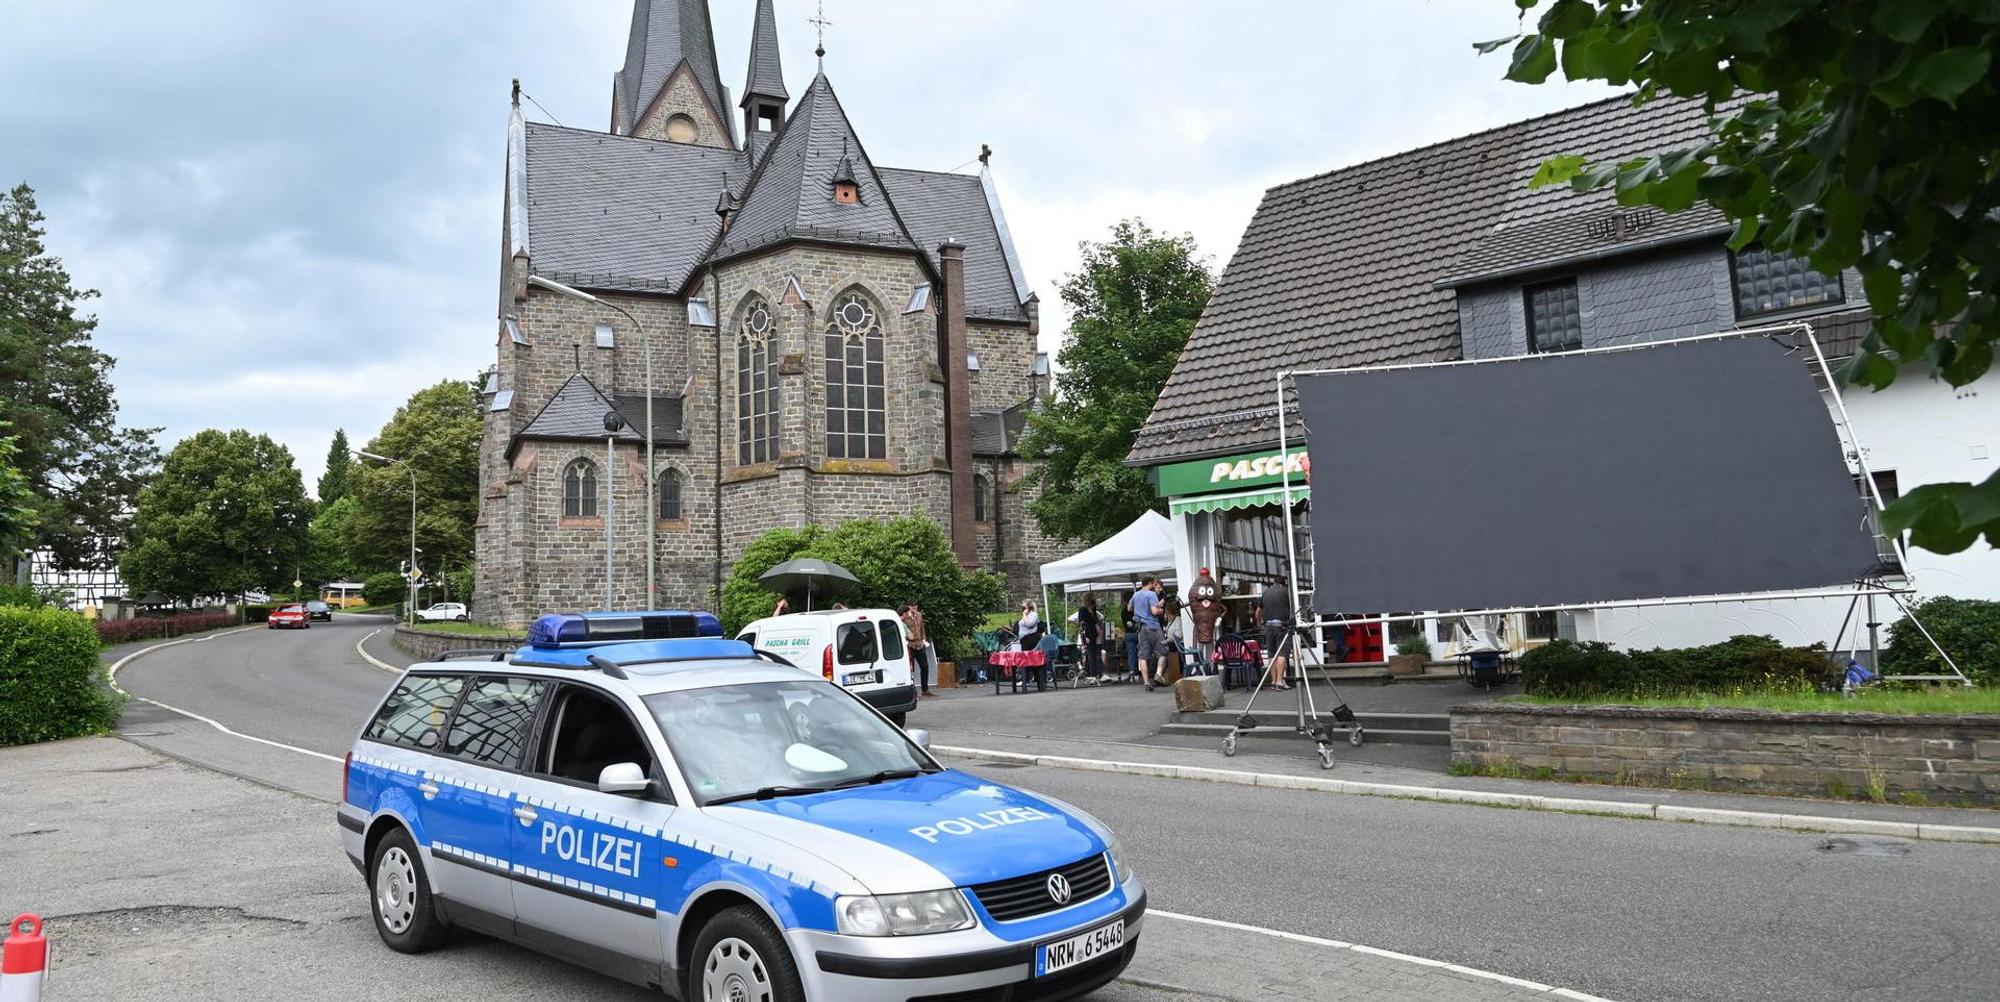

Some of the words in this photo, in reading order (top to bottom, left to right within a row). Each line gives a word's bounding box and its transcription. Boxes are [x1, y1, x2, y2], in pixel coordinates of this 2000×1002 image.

[791, 638, 810, 646] GRILL
[908, 806, 1053, 844] POLIZEI
[541, 821, 642, 879] POLIZEI
[1047, 941, 1075, 970] NRW
[1095, 923, 1123, 954] 5448
